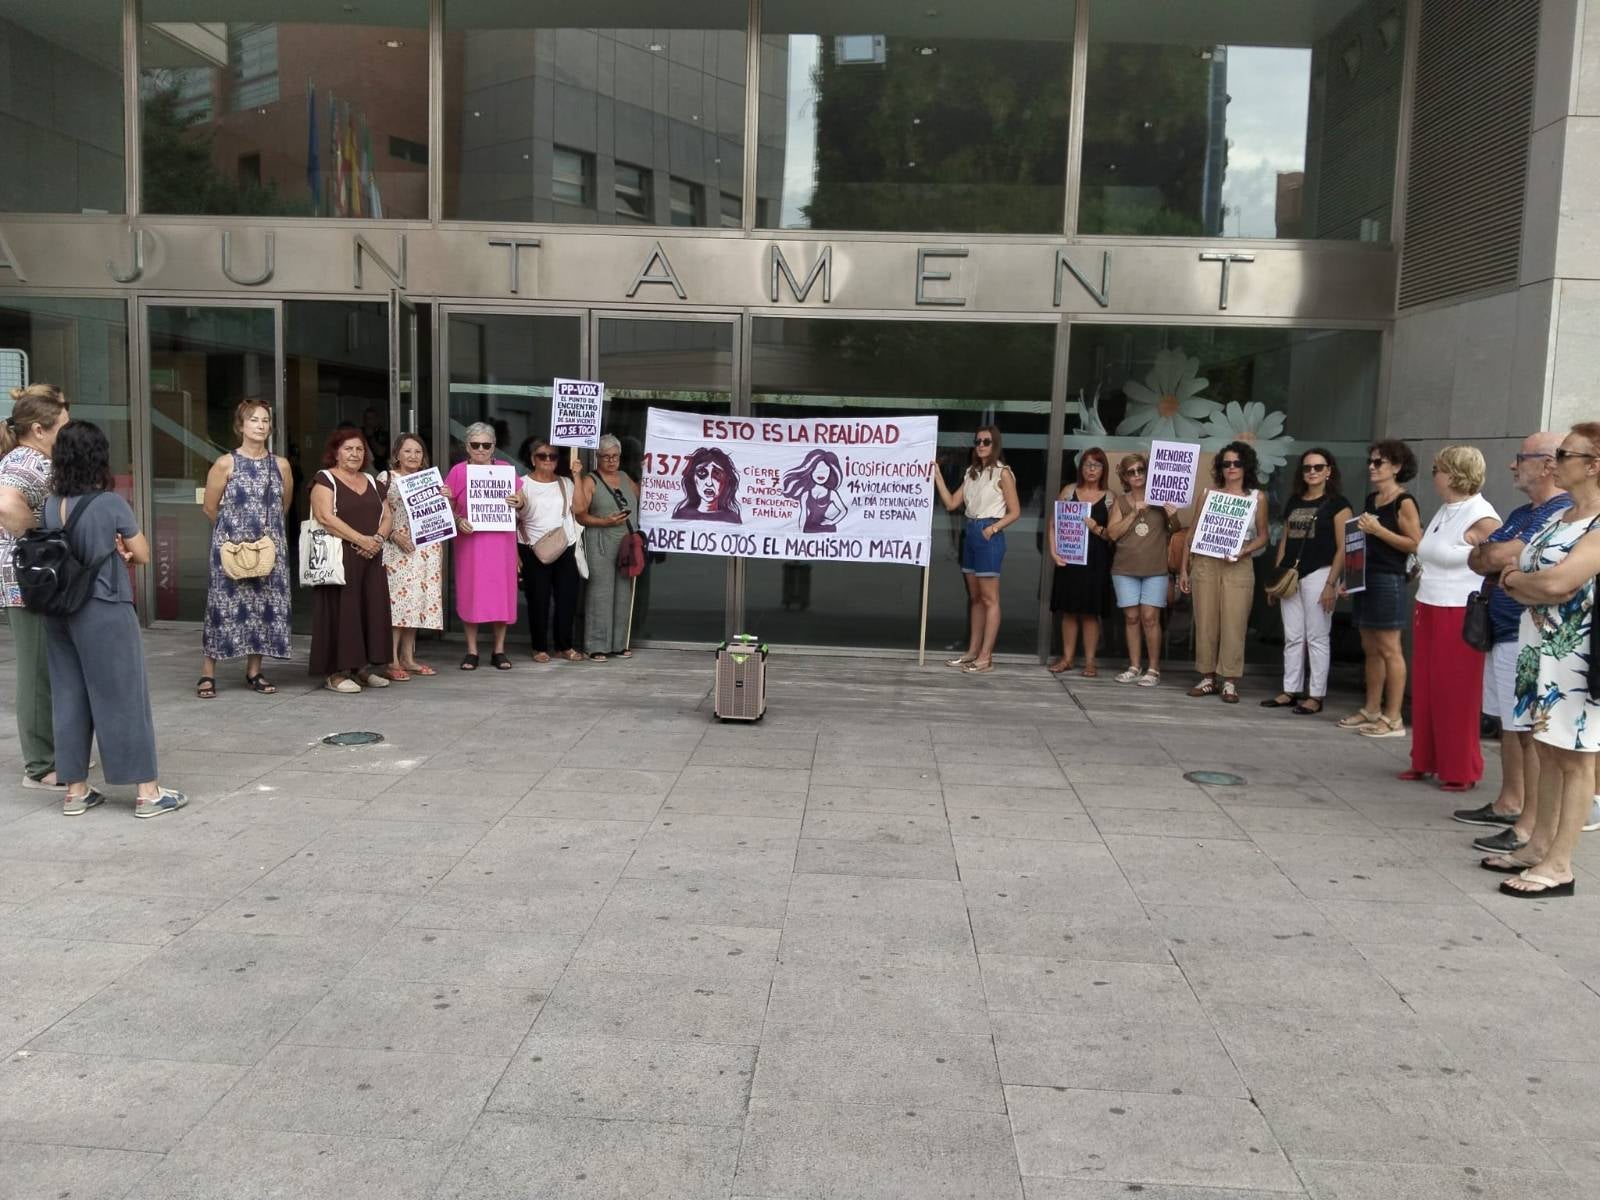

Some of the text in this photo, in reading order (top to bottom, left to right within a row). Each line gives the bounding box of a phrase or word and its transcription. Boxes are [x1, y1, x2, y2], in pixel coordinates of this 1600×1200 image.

[561, 384, 597, 395] PP-VOX
[557, 401, 598, 411] ENCUENTRO
[559, 409, 595, 418] FAMILIAR
[557, 426, 596, 435] NO SE TOCA
[703, 419, 755, 441] ESTO
[762, 423, 783, 442] ES
[788, 423, 809, 443] LA
[1156, 448, 1194, 464] MENORES
[643, 452, 694, 476] 1377
[470, 480, 512, 489] ESCUCHAD A
[755, 477, 780, 488] DE 7
[847, 480, 861, 494] 14
[1152, 474, 1190, 491] MADRES
[408, 487, 440, 505] CIERRA
[469, 489, 512, 498] LAS MADRES
[645, 491, 669, 501] DESDE
[747, 485, 783, 496] PUNTOS
[1150, 488, 1187, 504] SEGURAS.
[642, 500, 668, 512] 2003
[755, 497, 799, 508] ENCUENTRO
[851, 496, 862, 506] AL
[1224, 496, 1253, 509] LLAMAN
[411, 502, 447, 520] FAMILIAR
[470, 503, 512, 513] PROTEJED A
[863, 507, 917, 521] EN ESPAÑA
[471, 514, 512, 523] LA INFANCIA
[1203, 514, 1244, 530] NOSOTRAS
[1201, 524, 1241, 538] LO LLAMAMOS
[647, 527, 686, 551] ABRE
[690, 530, 717, 552] LOS
[721, 534, 757, 555] OJOS
[763, 537, 779, 556] EL
[1201, 533, 1238, 549] ABANDONO
